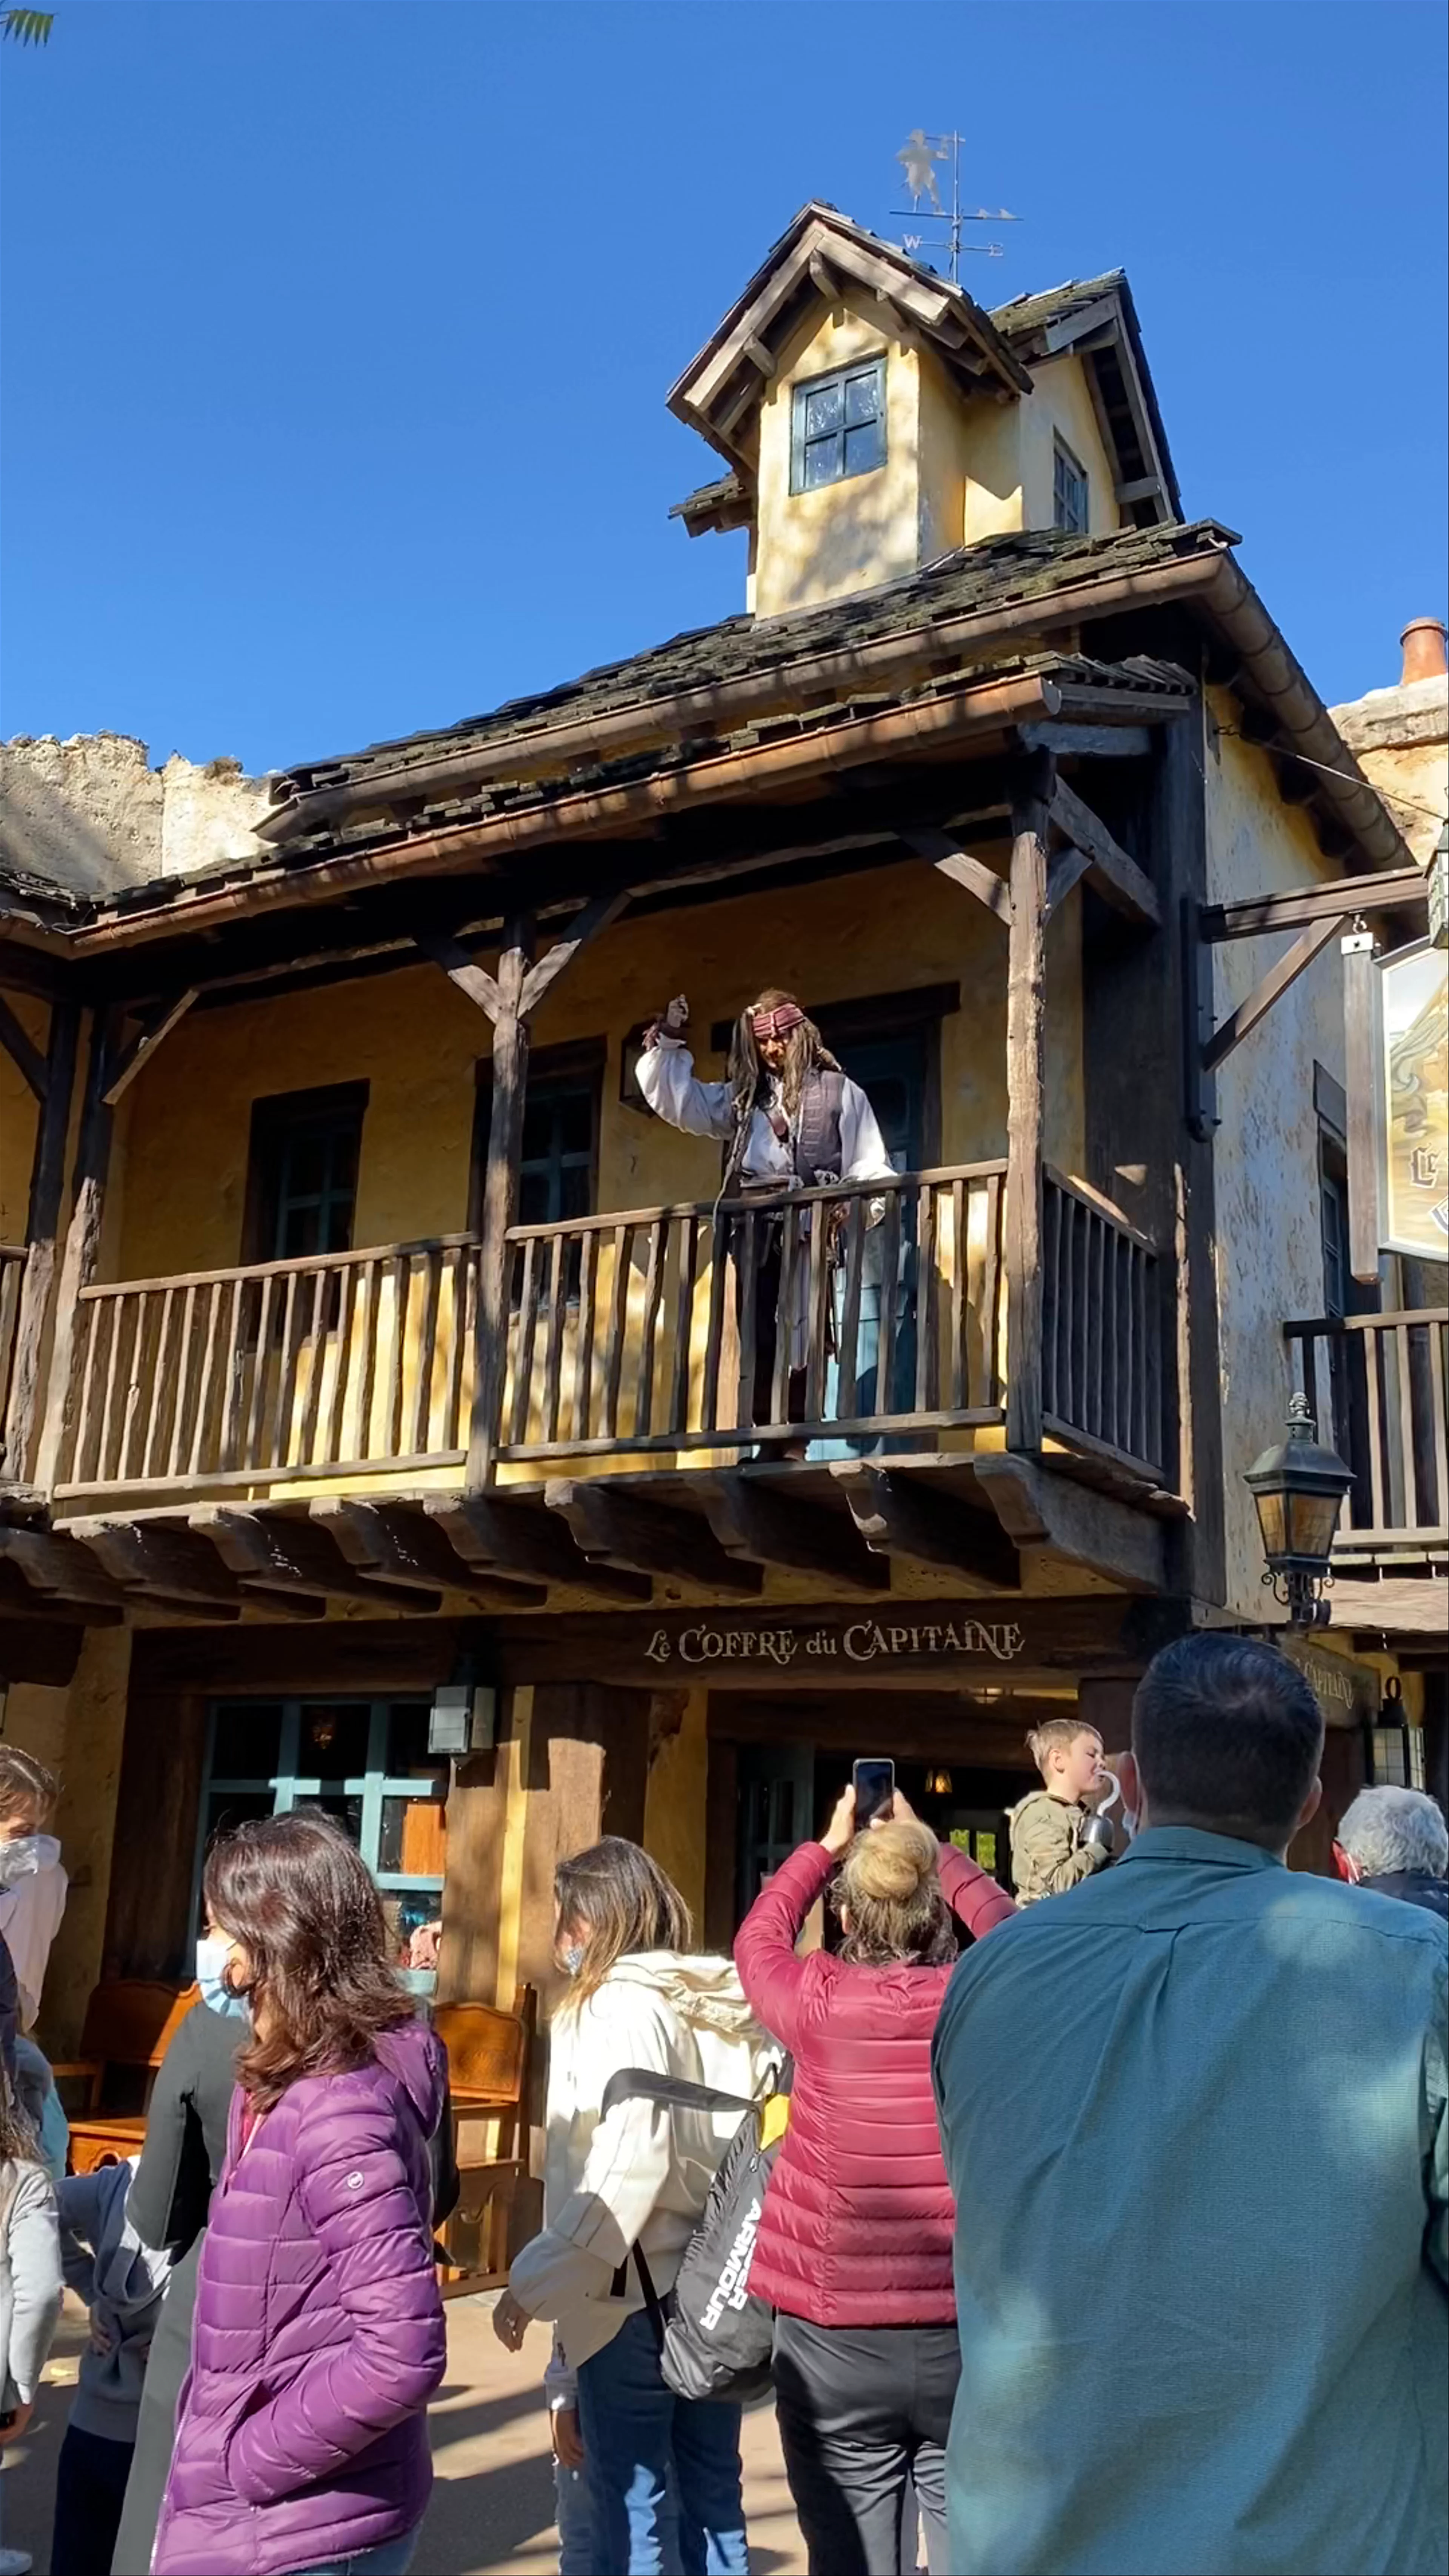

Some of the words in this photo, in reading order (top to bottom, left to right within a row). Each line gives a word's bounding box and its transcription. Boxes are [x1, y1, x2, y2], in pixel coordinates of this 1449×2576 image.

[903, 234, 921, 249] W
[1409, 1143, 1440, 1187] Le
[644, 1629, 671, 1662] Le
[678, 1624, 798, 1665] COFFRE
[806, 1629, 837, 1654] du
[843, 1619, 1025, 1661] CAPITAINE
[700, 2198, 761, 2330] ARMOUR
